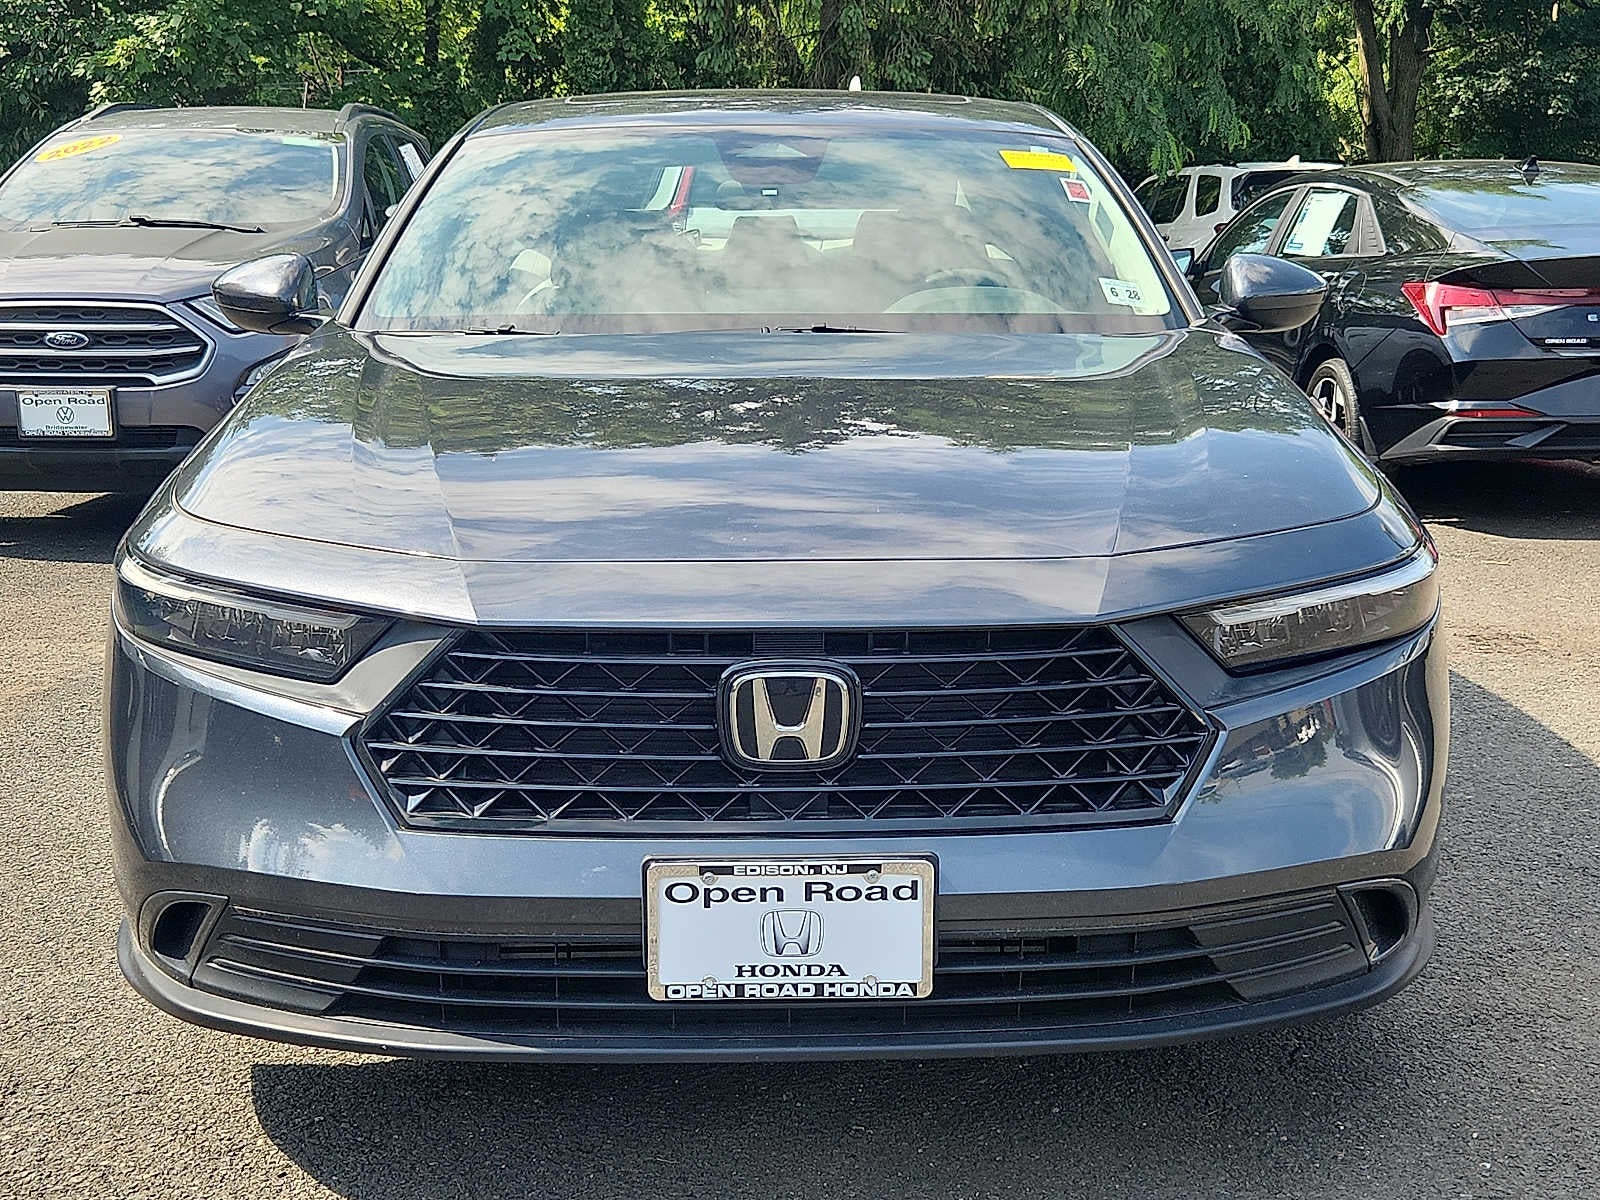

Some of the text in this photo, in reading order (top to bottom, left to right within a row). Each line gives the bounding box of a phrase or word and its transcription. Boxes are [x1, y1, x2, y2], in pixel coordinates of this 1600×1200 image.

[1110, 287, 1141, 301] 6 28
[54, 334, 78, 345] Ford
[22, 397, 105, 407] Open Road
[733, 864, 848, 876] EDISON, NJ
[664, 880, 919, 908] Open Road
[734, 964, 848, 978] HONDA
[667, 982, 915, 998] OPEN ROAD HONDA
